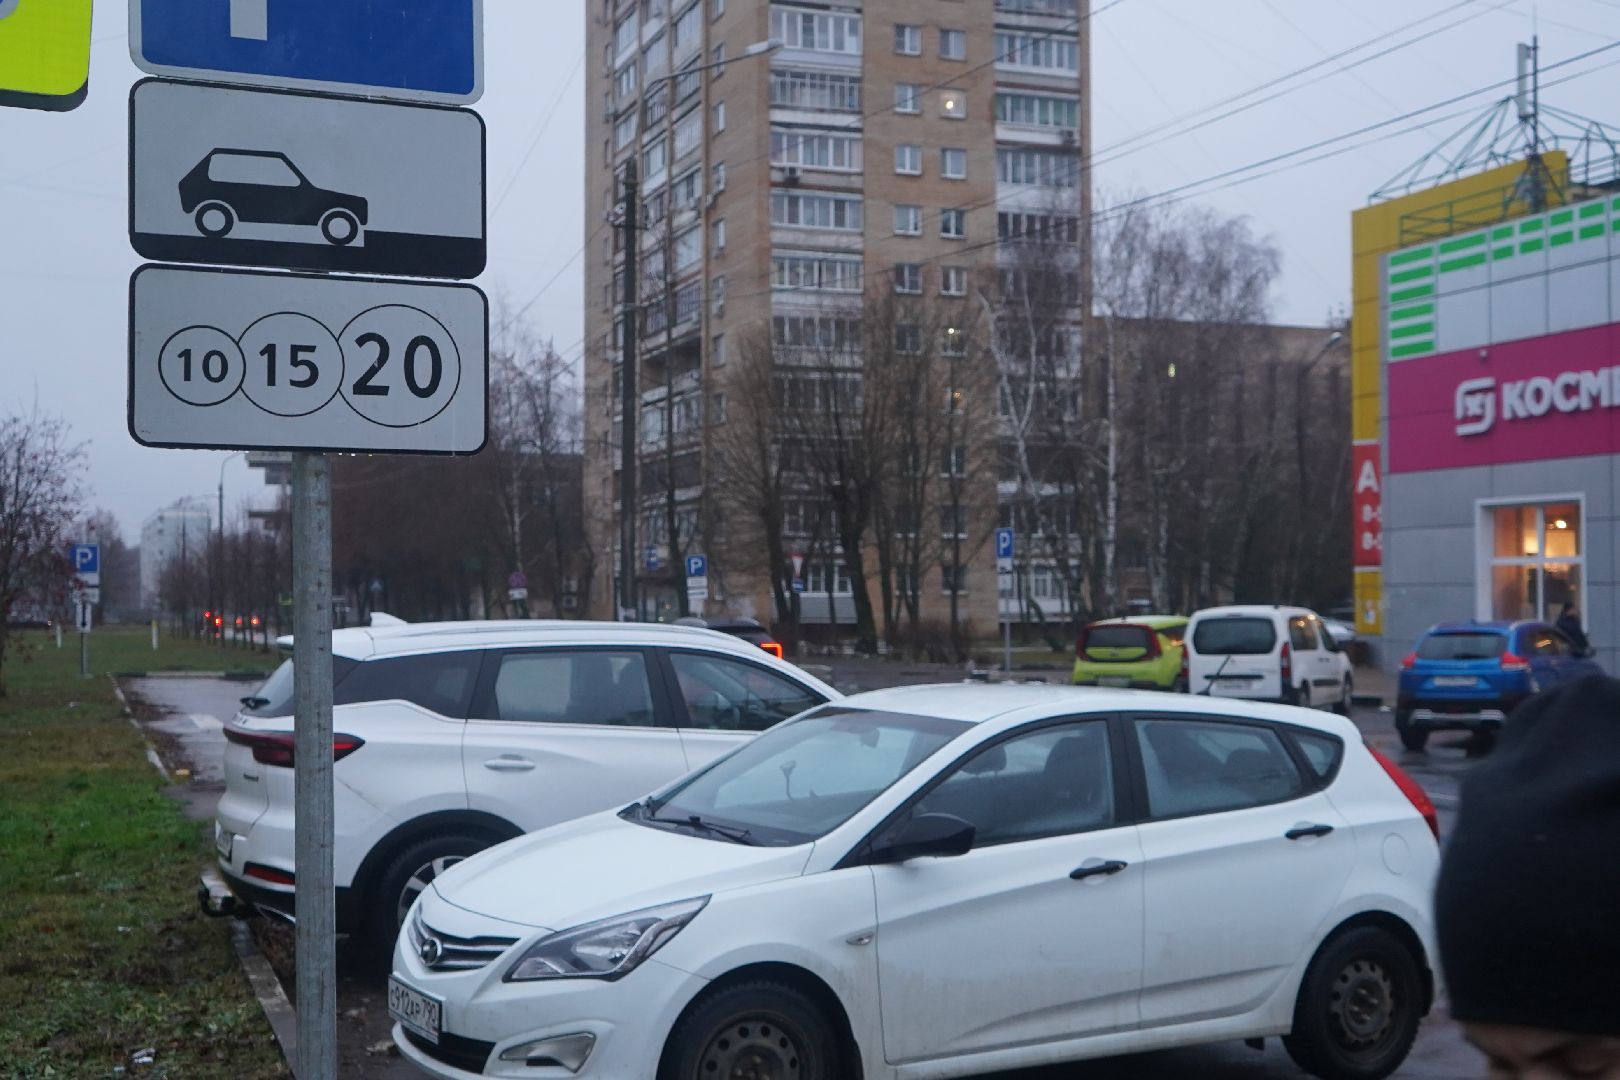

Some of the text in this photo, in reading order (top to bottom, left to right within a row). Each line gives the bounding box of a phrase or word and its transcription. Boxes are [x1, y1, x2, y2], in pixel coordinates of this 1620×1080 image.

[177, 332, 443, 399] 10 15 20
[999, 532, 1011, 556] P
[76, 548, 92, 571] P
[690, 557, 703, 575] P
